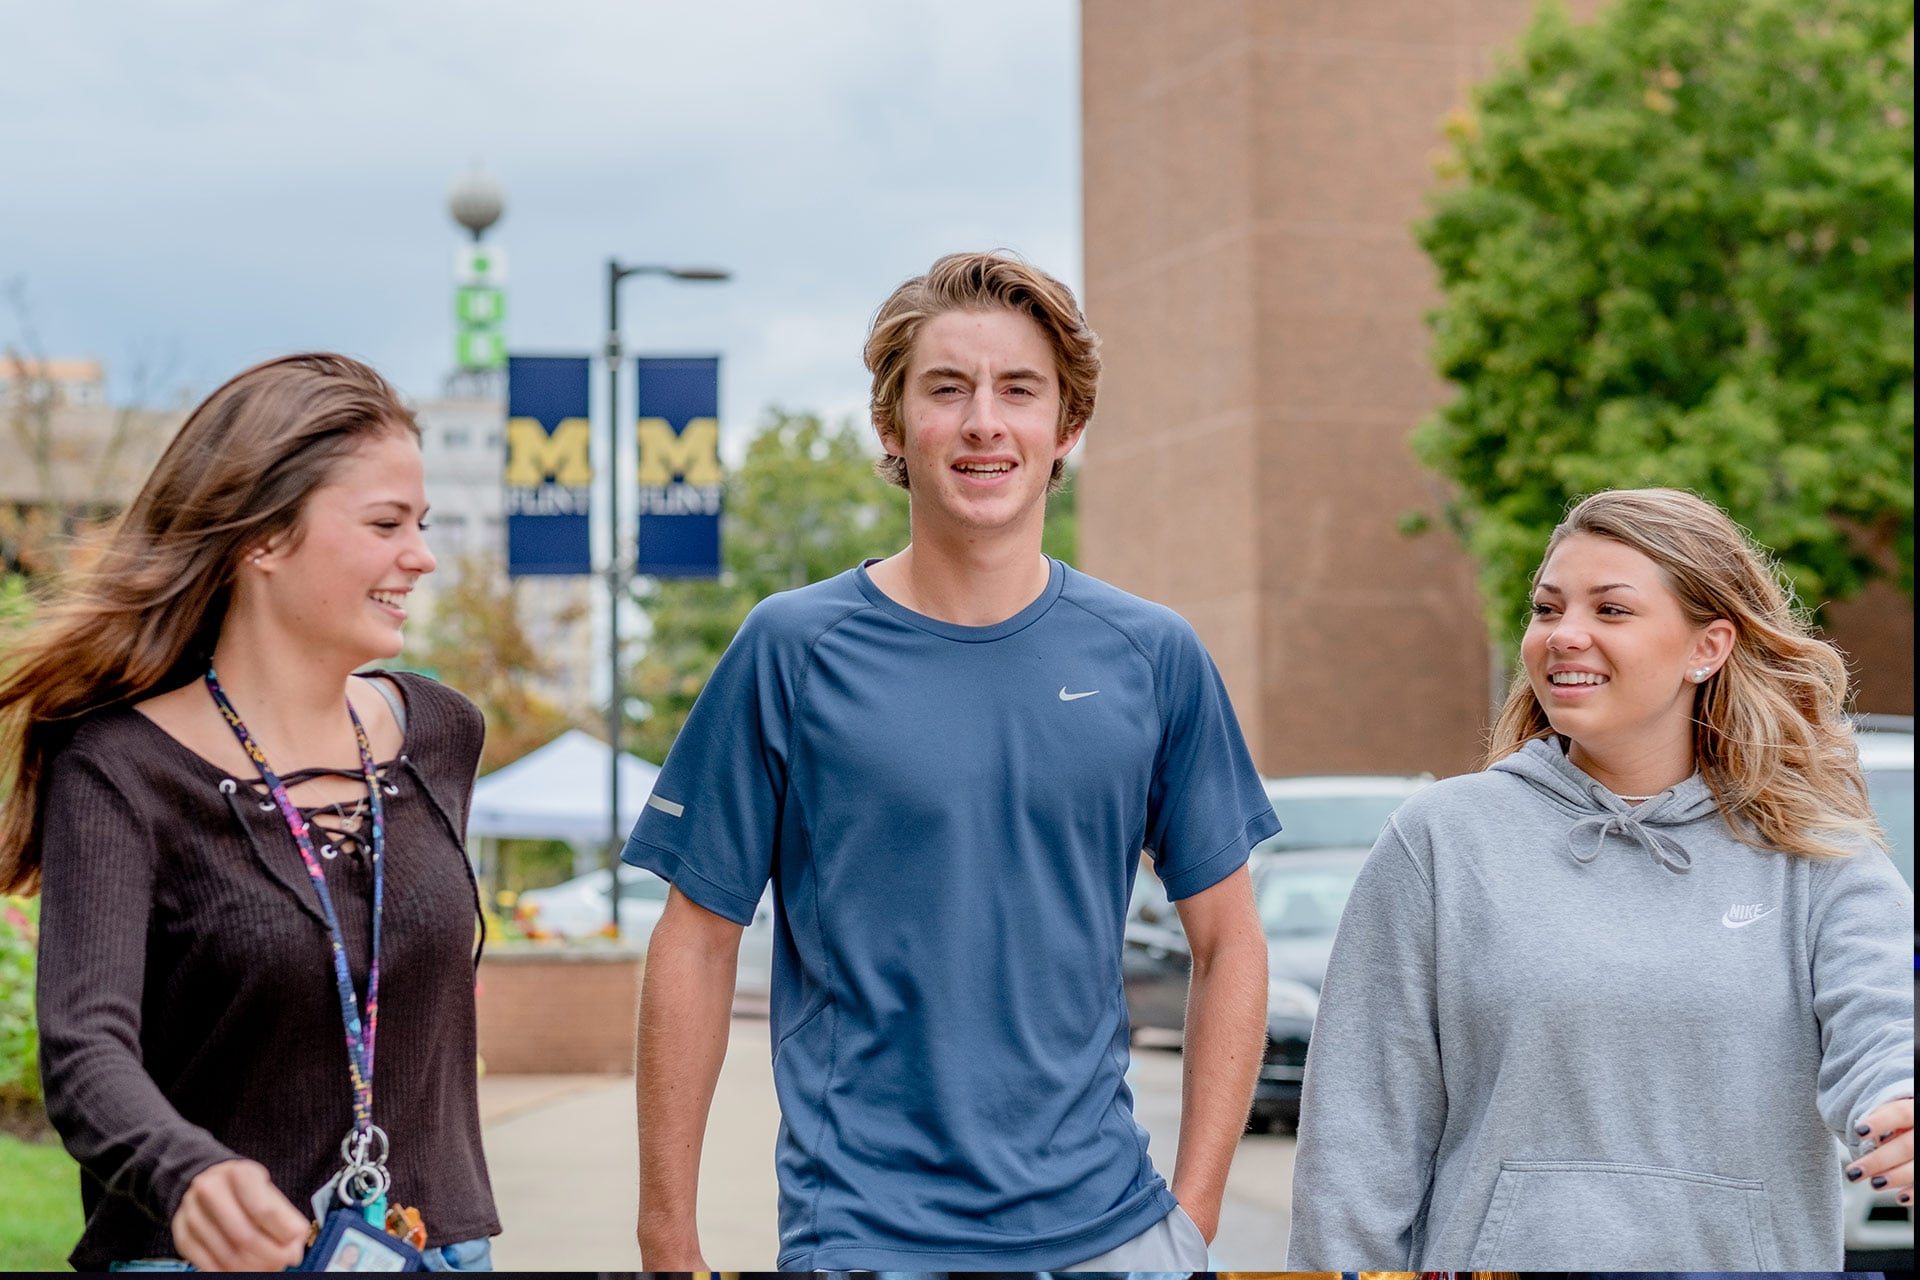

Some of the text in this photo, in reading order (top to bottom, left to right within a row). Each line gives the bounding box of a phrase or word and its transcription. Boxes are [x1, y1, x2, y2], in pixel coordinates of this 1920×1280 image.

[506, 417, 592, 484] M
[637, 417, 722, 484] M
[506, 484, 590, 515] FLINT
[637, 484, 721, 515] FLINT
[1728, 903, 1763, 919] NIKE
